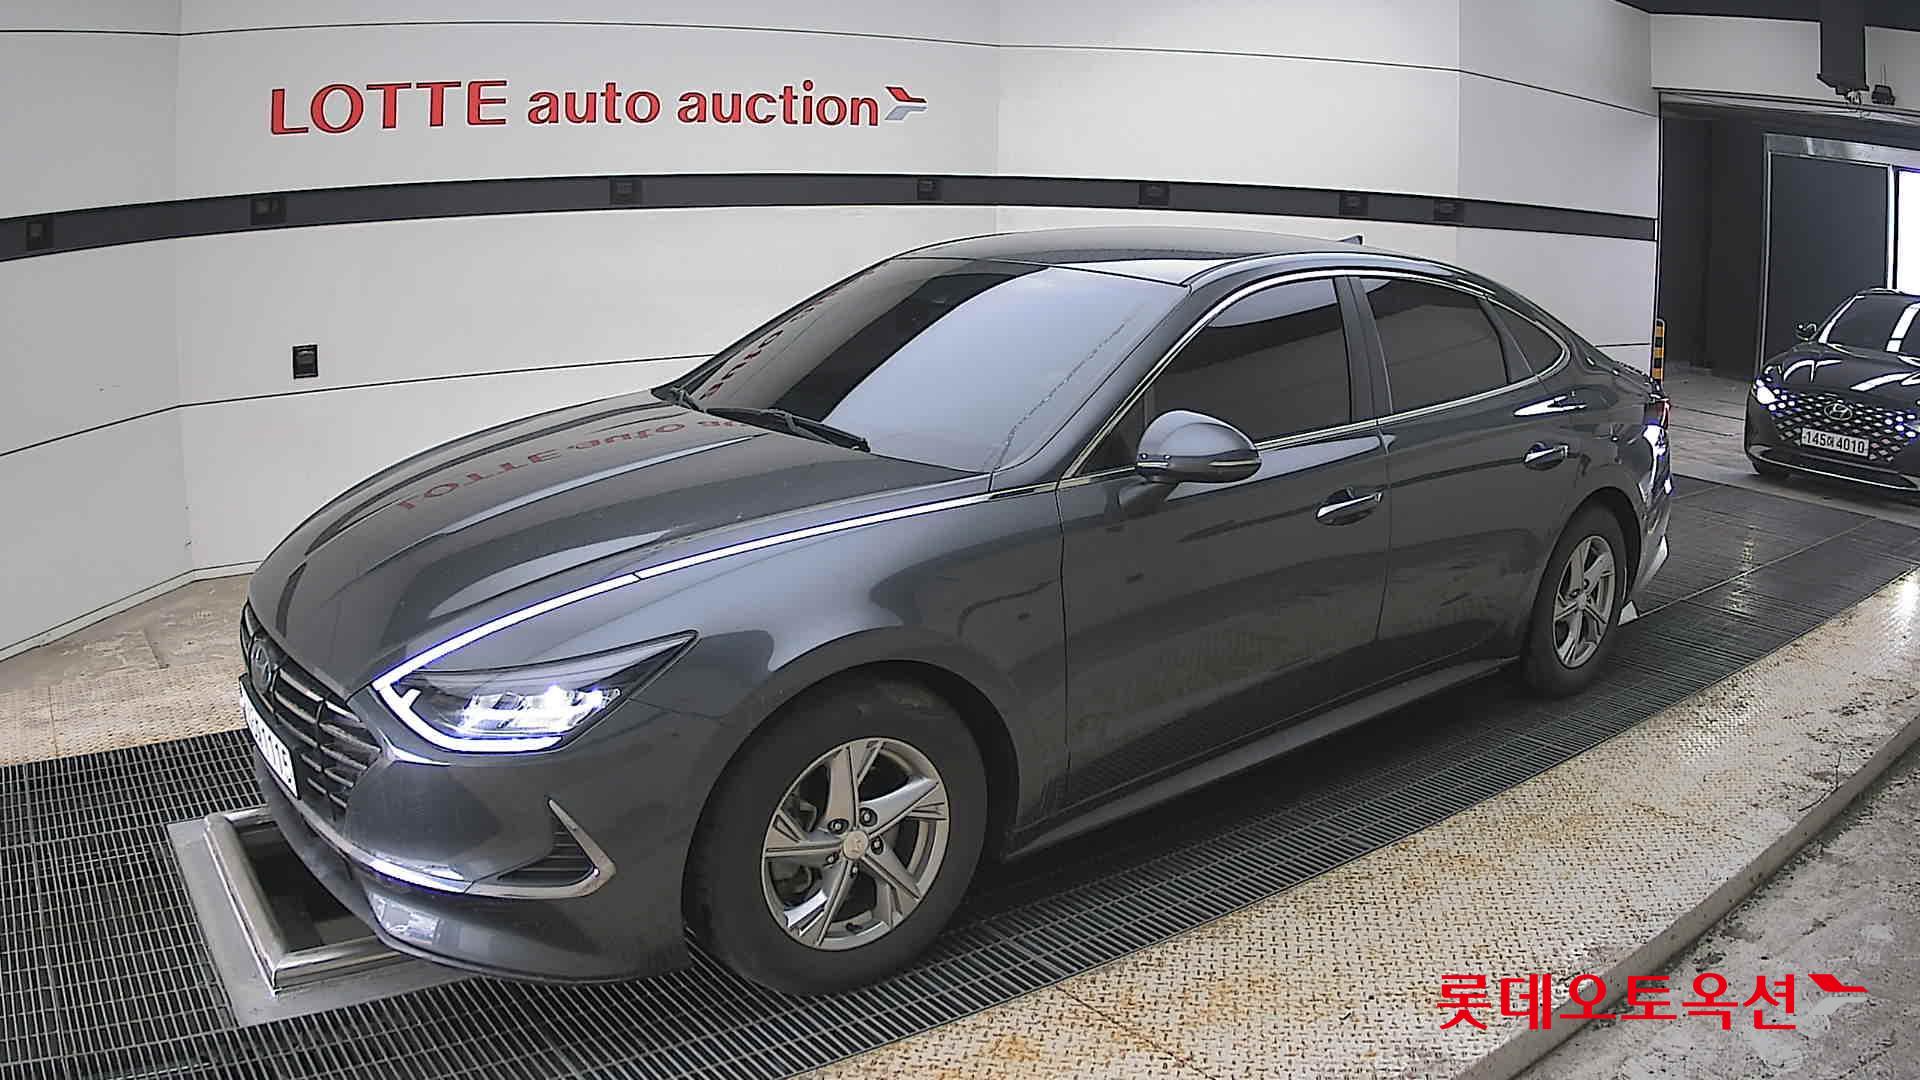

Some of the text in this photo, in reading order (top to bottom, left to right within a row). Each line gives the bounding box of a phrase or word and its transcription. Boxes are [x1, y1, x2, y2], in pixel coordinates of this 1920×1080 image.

[271, 79, 879, 135] LOTTE auto auction
[1836, 437, 1865, 454] 4010
